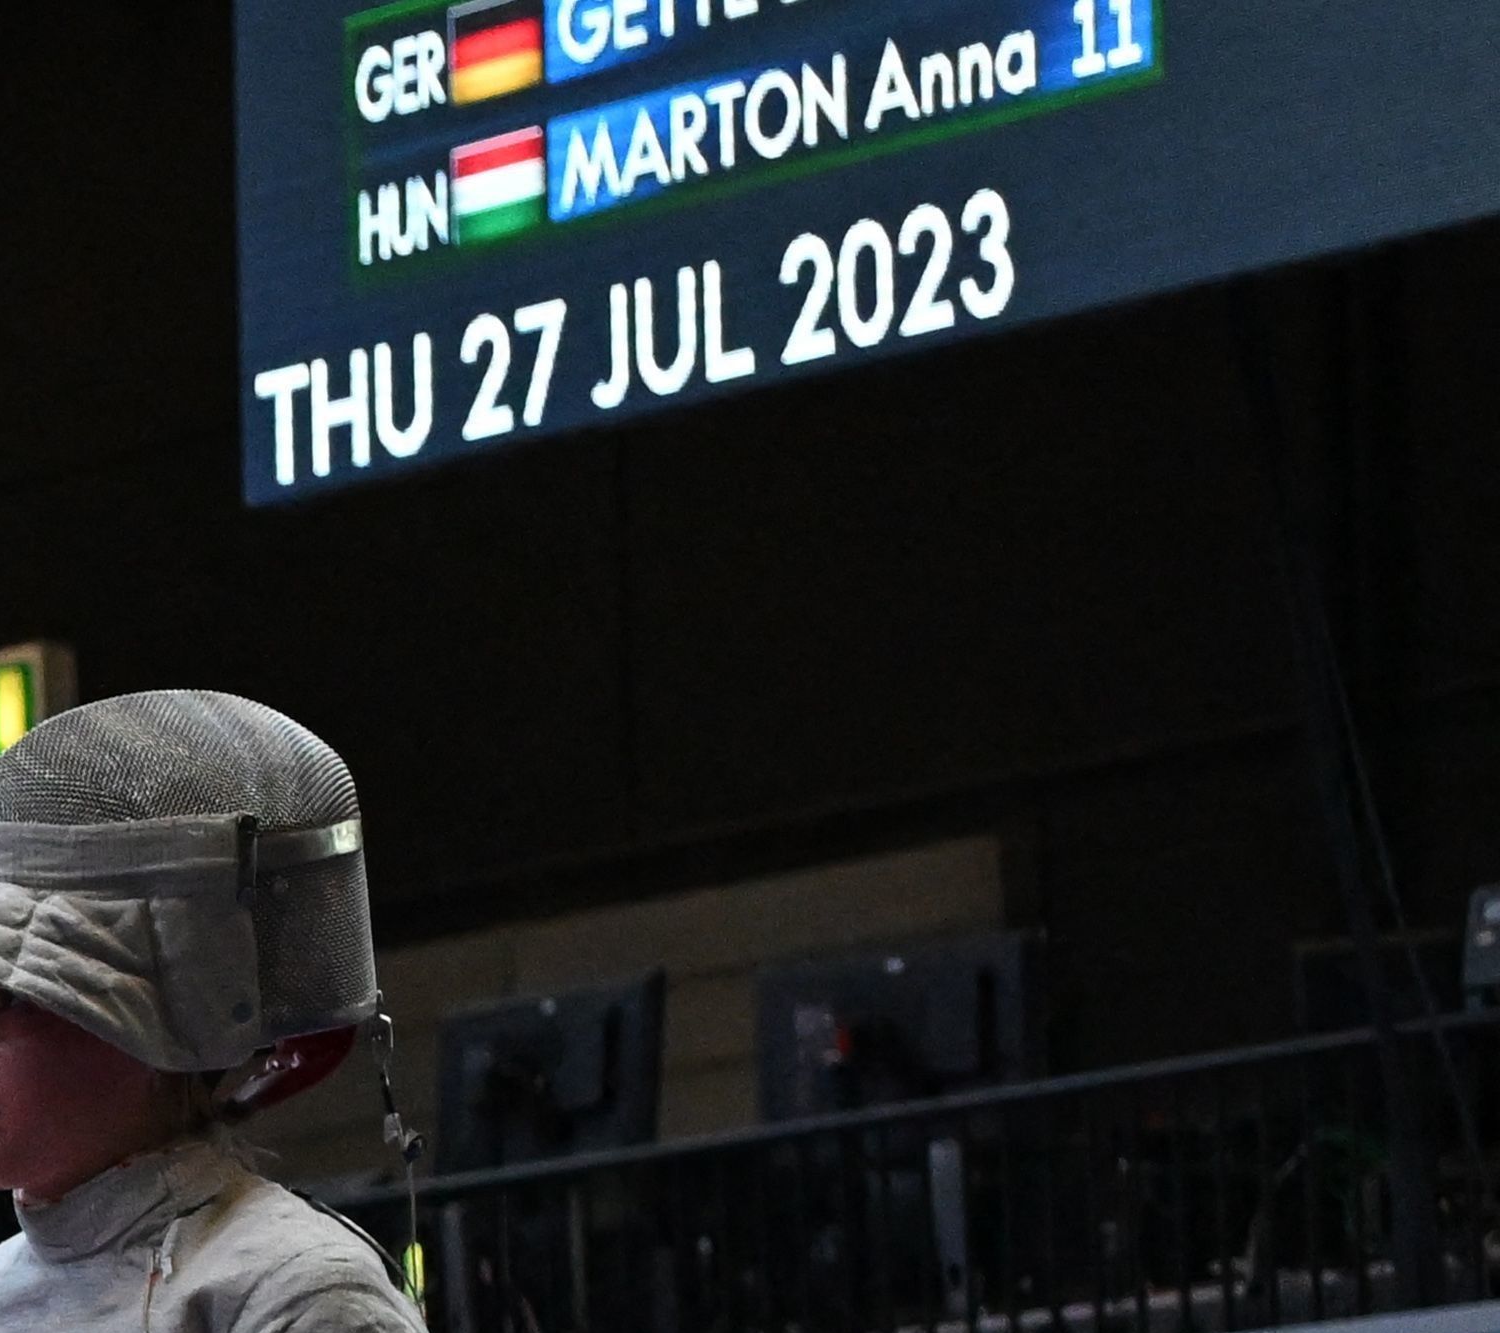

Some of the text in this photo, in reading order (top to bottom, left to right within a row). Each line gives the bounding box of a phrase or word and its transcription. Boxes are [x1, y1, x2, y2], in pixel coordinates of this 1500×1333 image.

[353, 30, 446, 122] GER
[358, 0, 1143, 264] HUN MARTON Anna 11
[254, 188, 1015, 485] THU 27 JUL 2023
